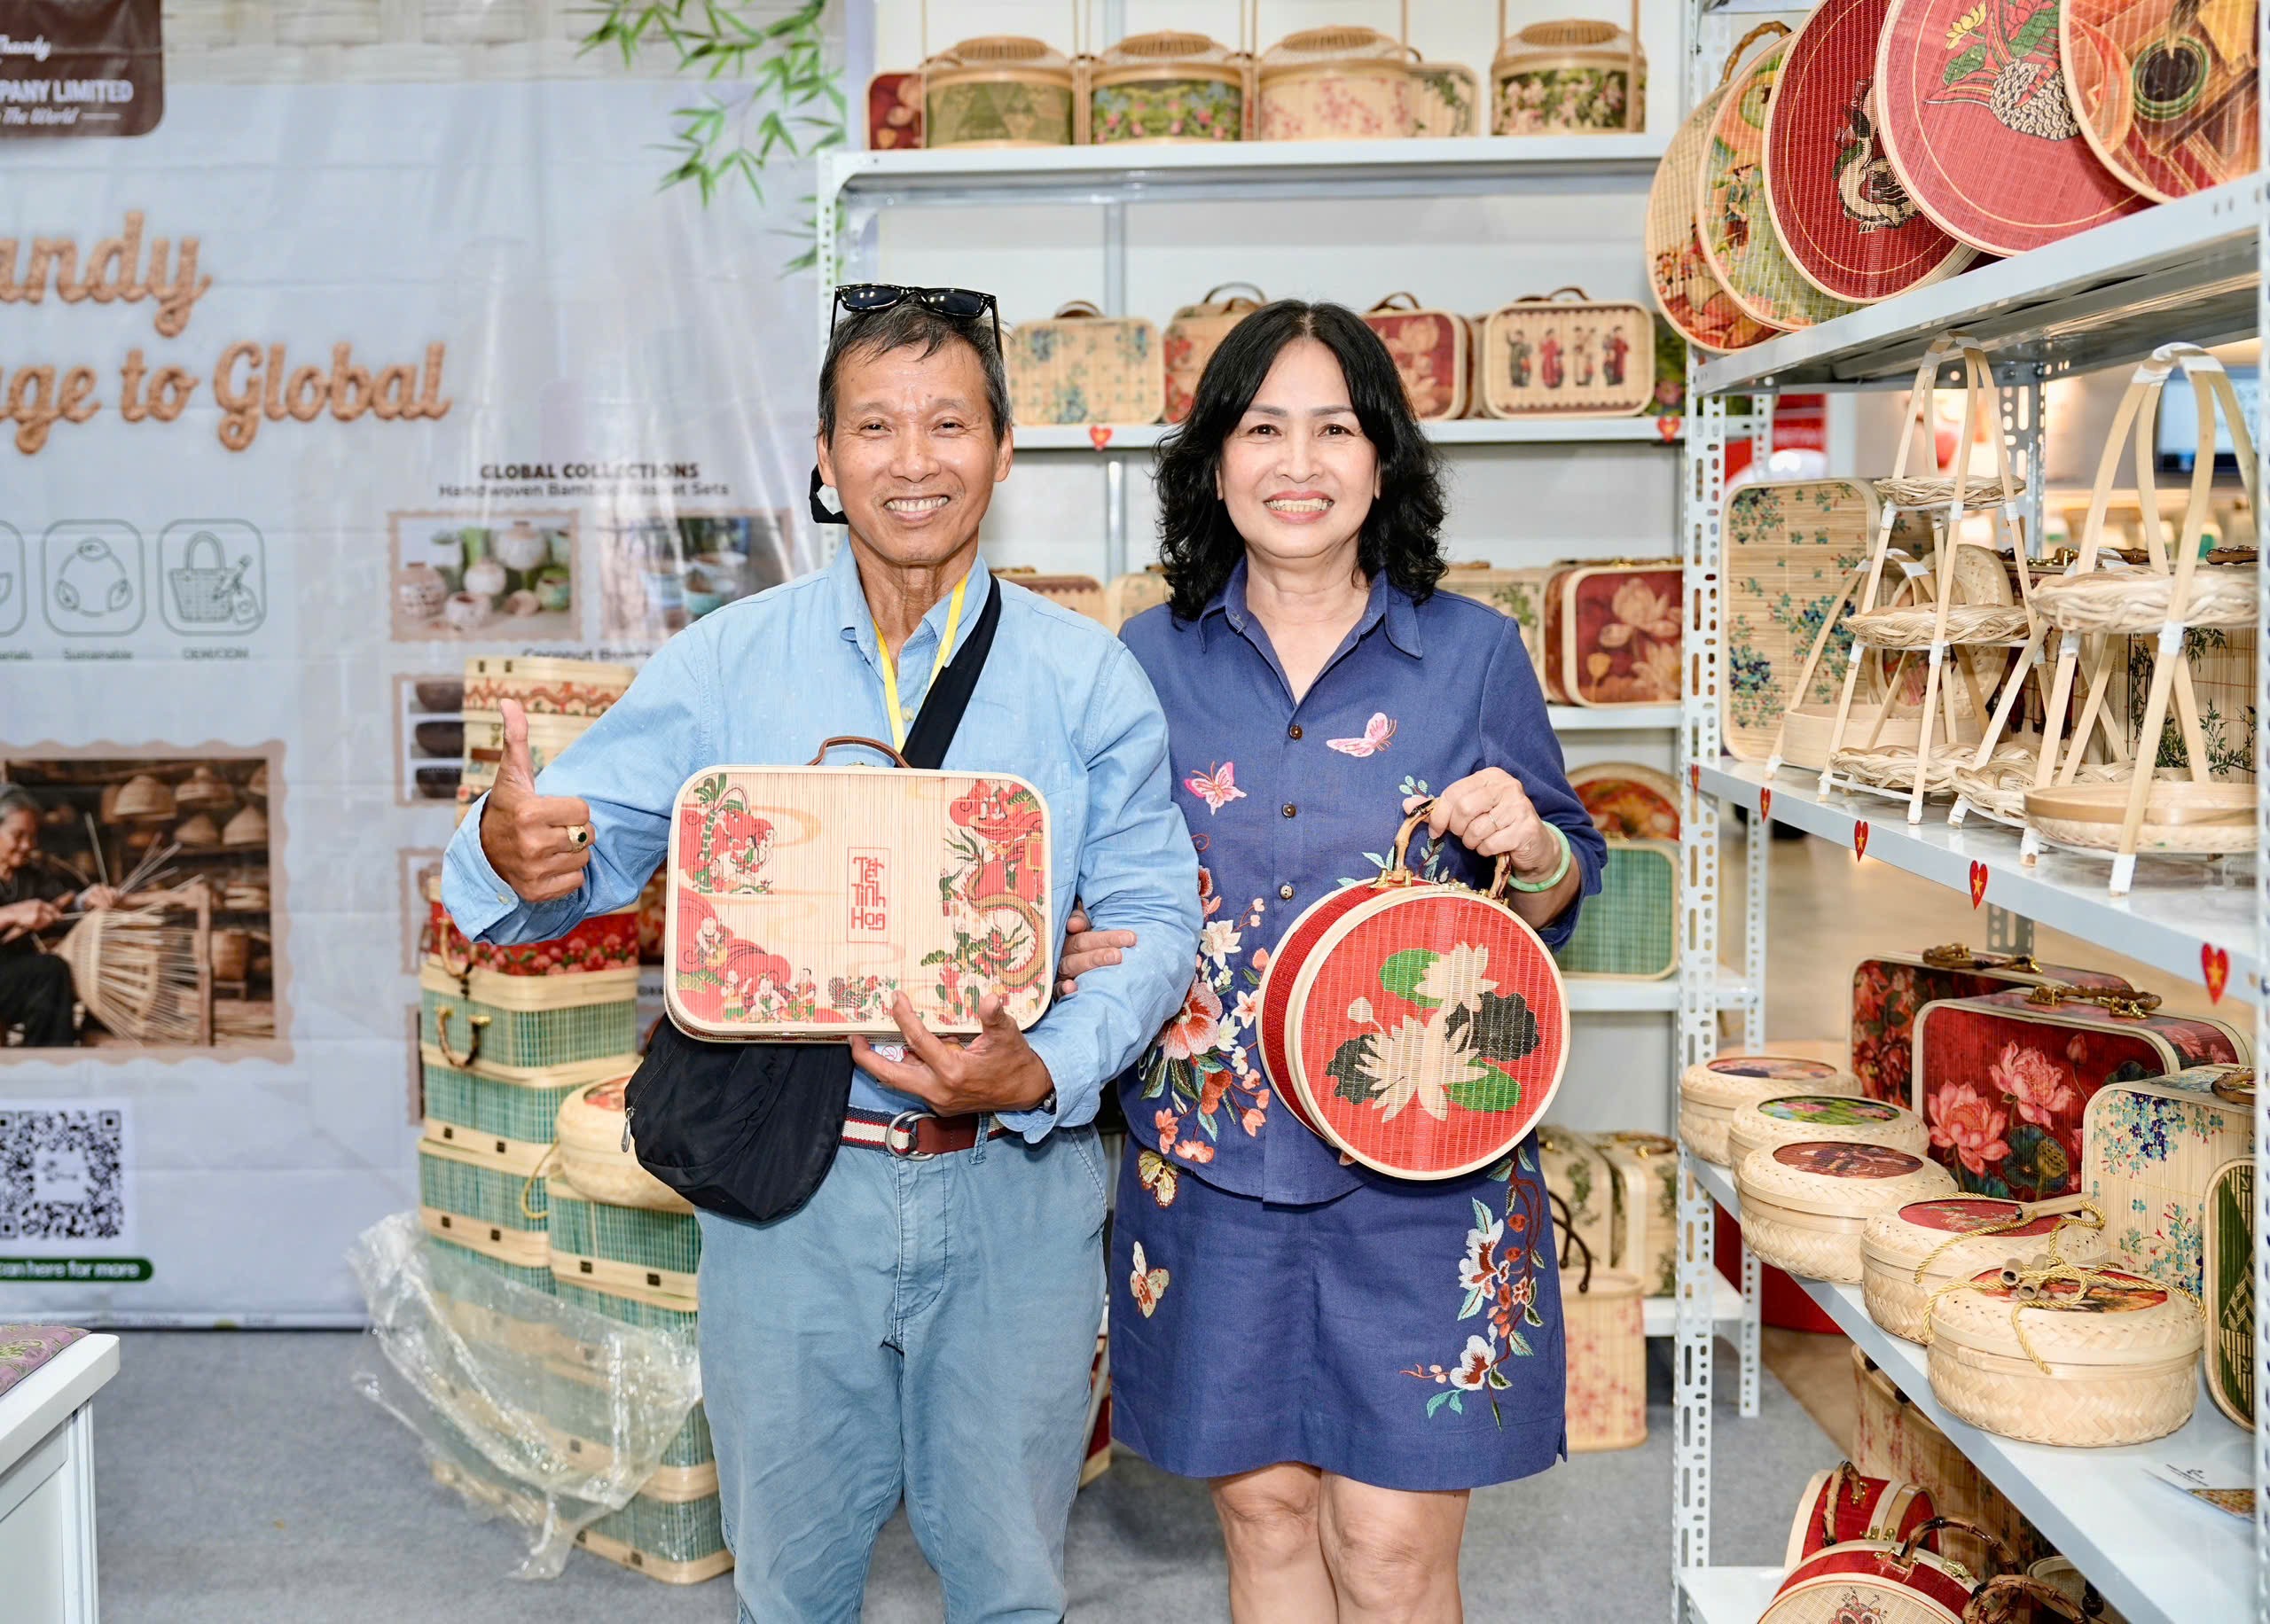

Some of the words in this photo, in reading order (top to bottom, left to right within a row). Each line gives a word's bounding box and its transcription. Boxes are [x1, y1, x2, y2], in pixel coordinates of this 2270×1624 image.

[52, 79, 134, 103] LIMITED
[3, 106, 29, 126] The
[29, 106, 81, 125] World
[0, 363, 102, 455] ge
[120, 348, 200, 423] to
[213, 341, 452, 451] Global
[480, 464, 555, 480] GLOBAL
[27, 1260, 67, 1277] here
[67, 1260, 91, 1277] for
[93, 1262, 140, 1277] more
